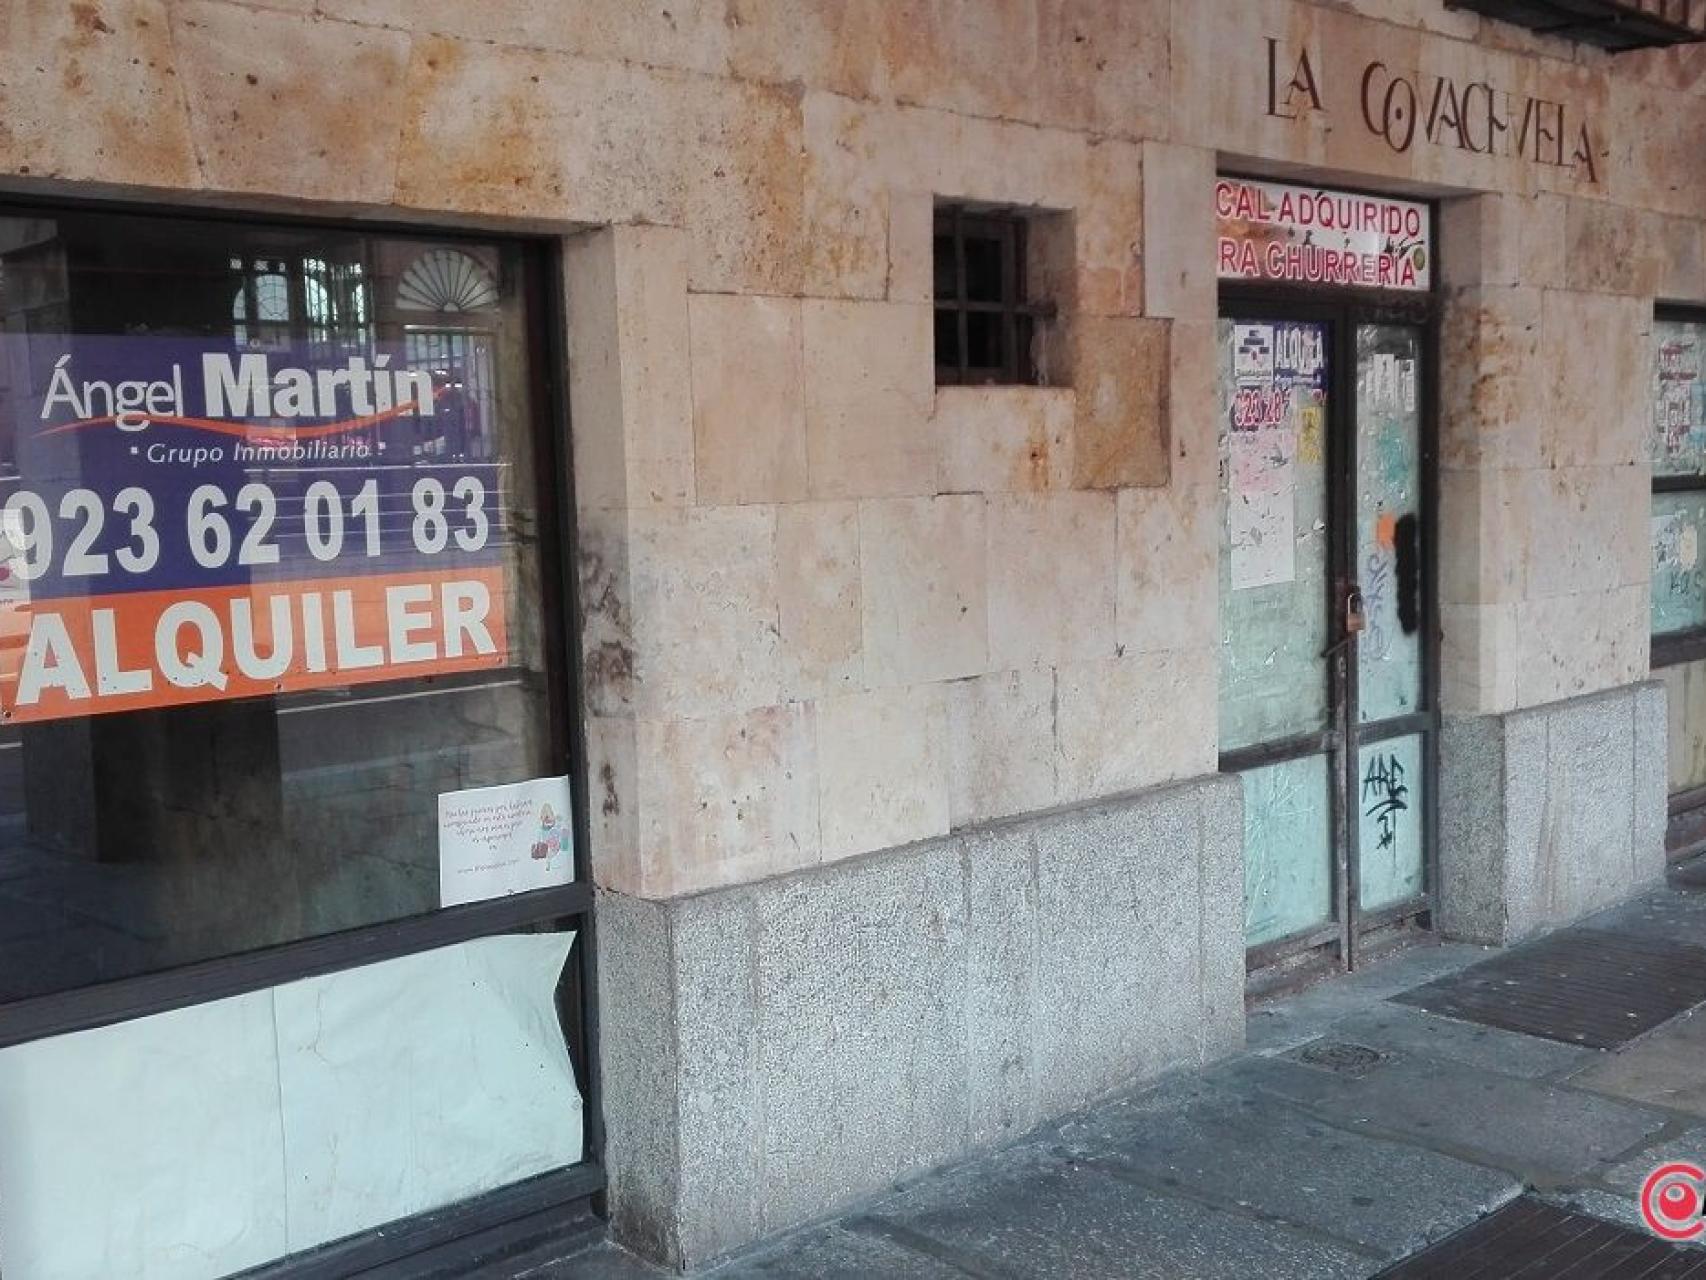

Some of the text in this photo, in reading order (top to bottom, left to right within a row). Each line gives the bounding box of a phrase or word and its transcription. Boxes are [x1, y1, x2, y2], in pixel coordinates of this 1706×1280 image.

[1263, 36, 1326, 121] LA
[1216, 182, 1421, 238] CAL ADQUIRIDO
[1218, 237, 1260, 277] RA
[40, 352, 435, 432] Ángel Martín
[147, 438, 369, 468] Grupo Inmobiliario
[3, 476, 489, 581] 923 62 01 83
[14, 579, 499, 706] ALQUILER
